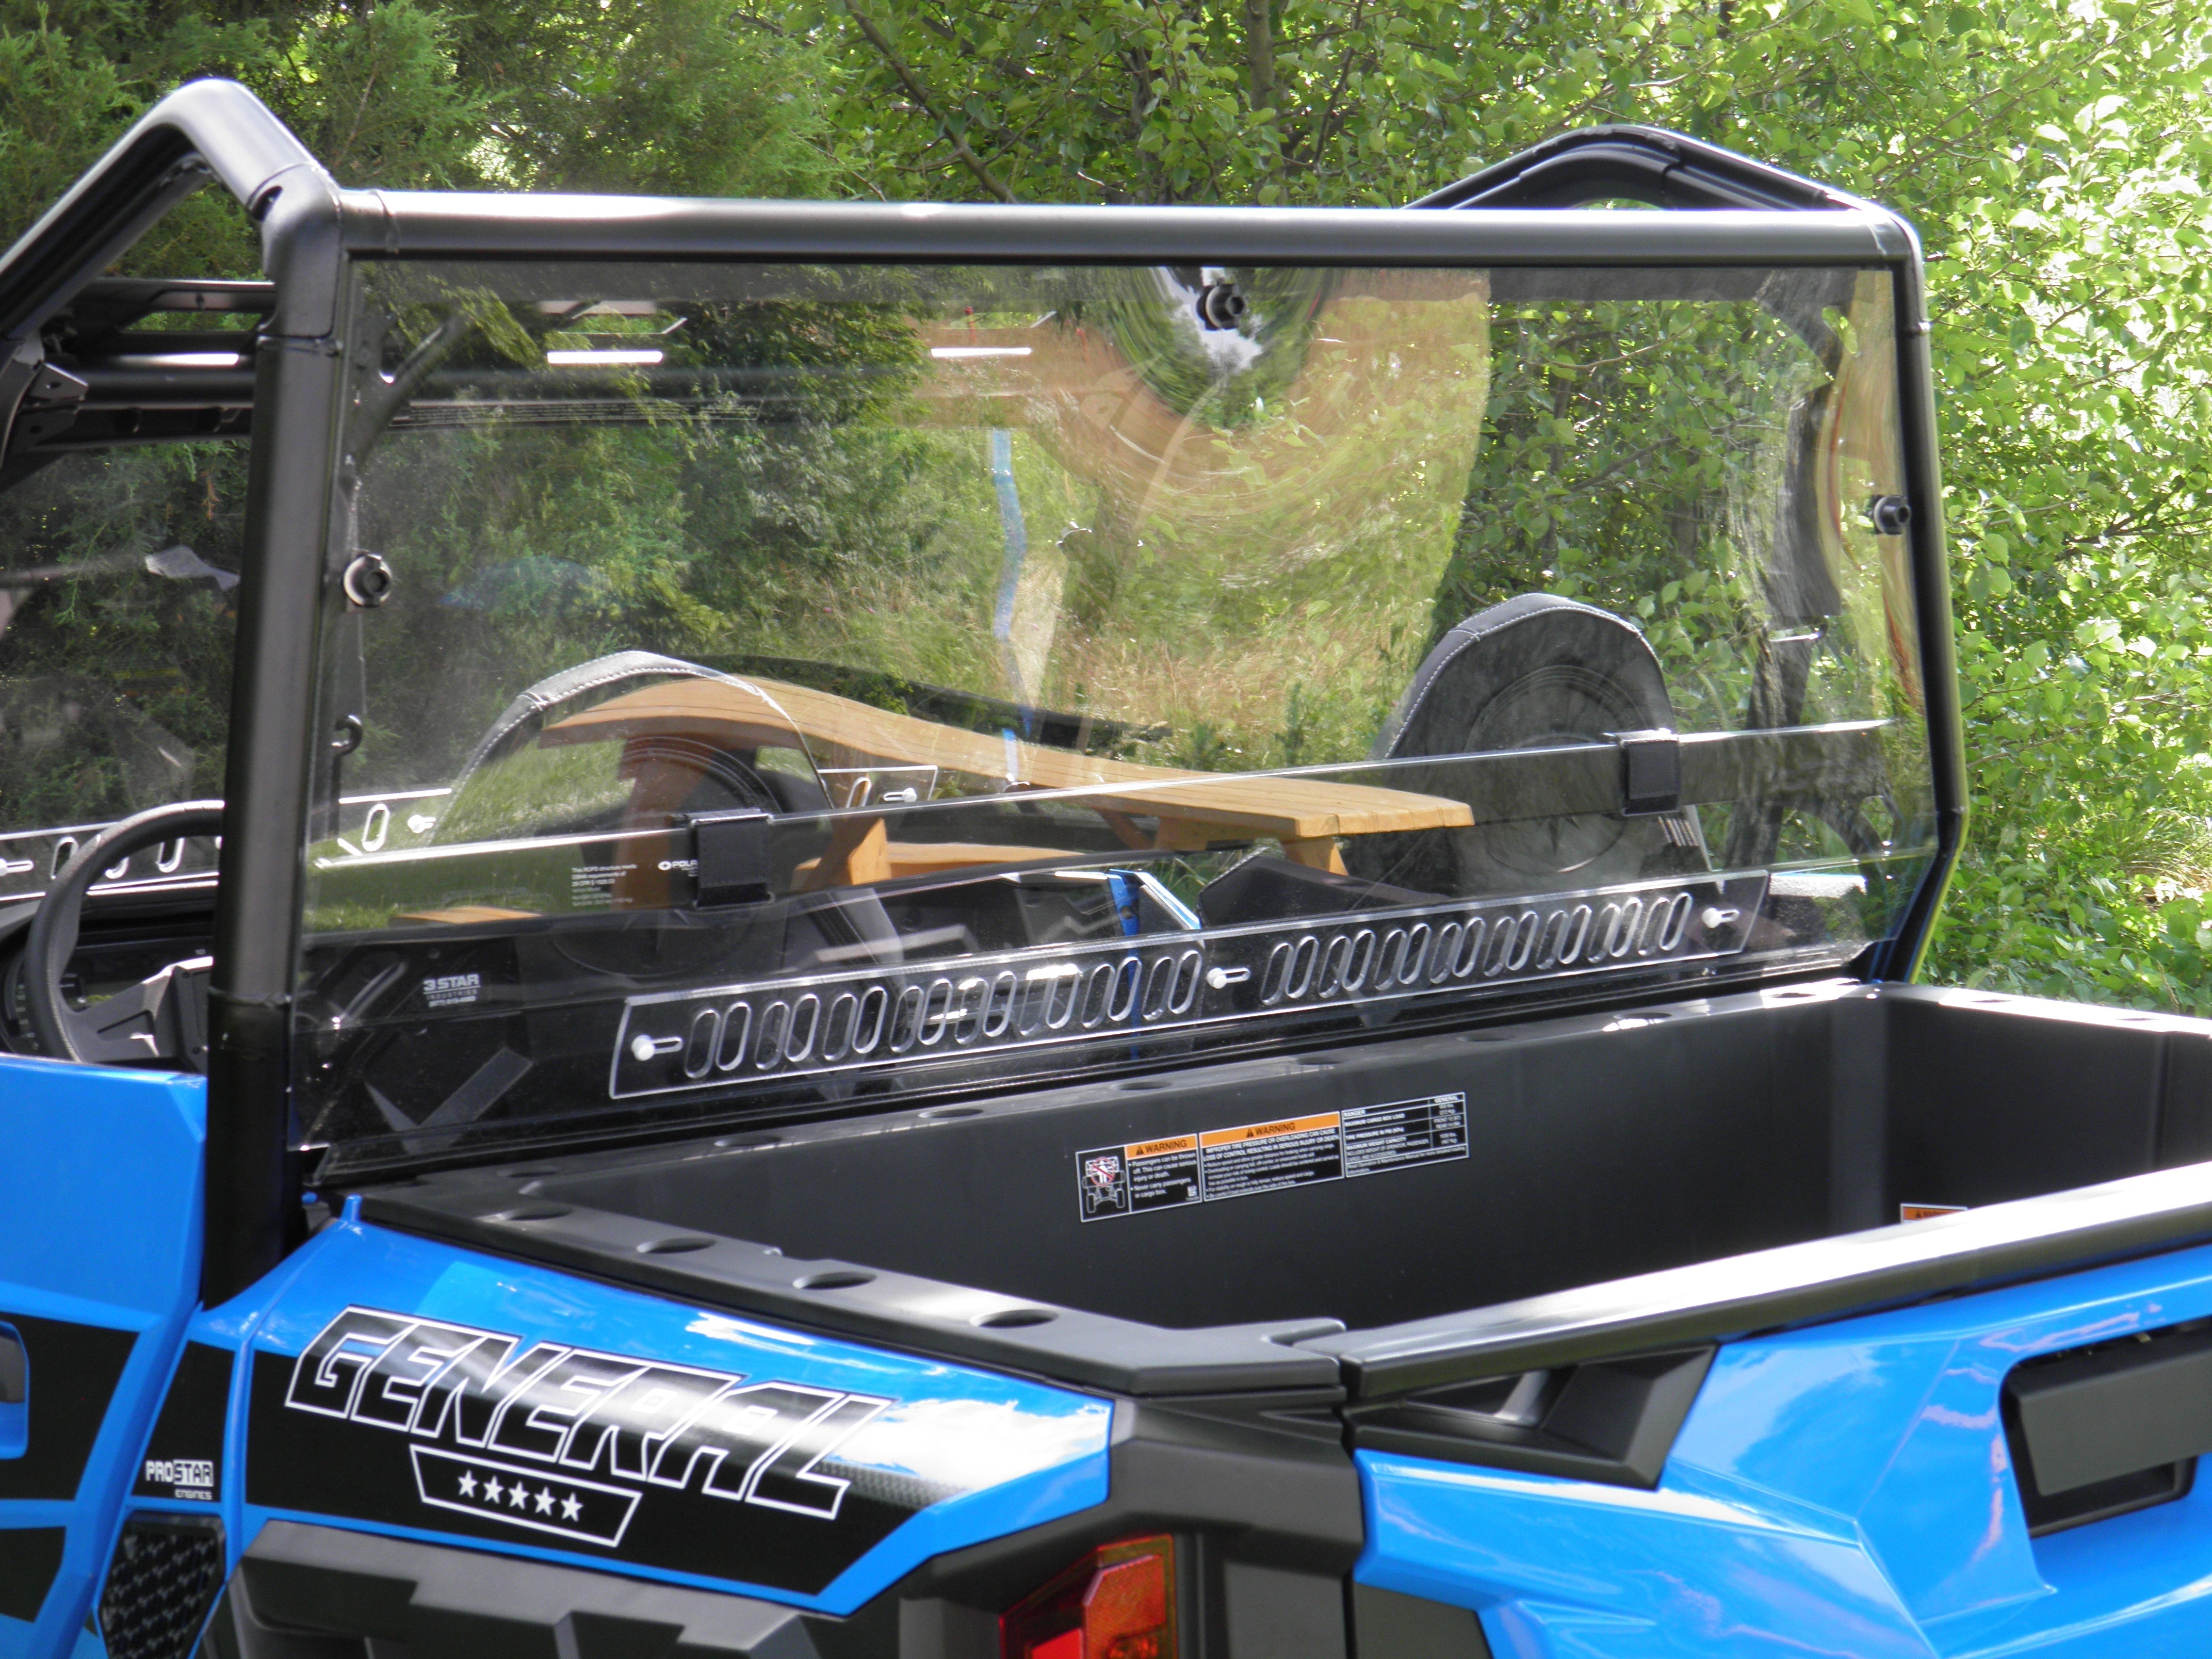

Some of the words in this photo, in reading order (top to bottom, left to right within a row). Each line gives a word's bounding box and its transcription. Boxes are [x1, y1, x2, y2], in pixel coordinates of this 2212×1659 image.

[1256, 1123, 1295, 1135] WARNING
[1145, 1140, 1187, 1152] WARNING
[284, 1306, 896, 1519] GENERAL
